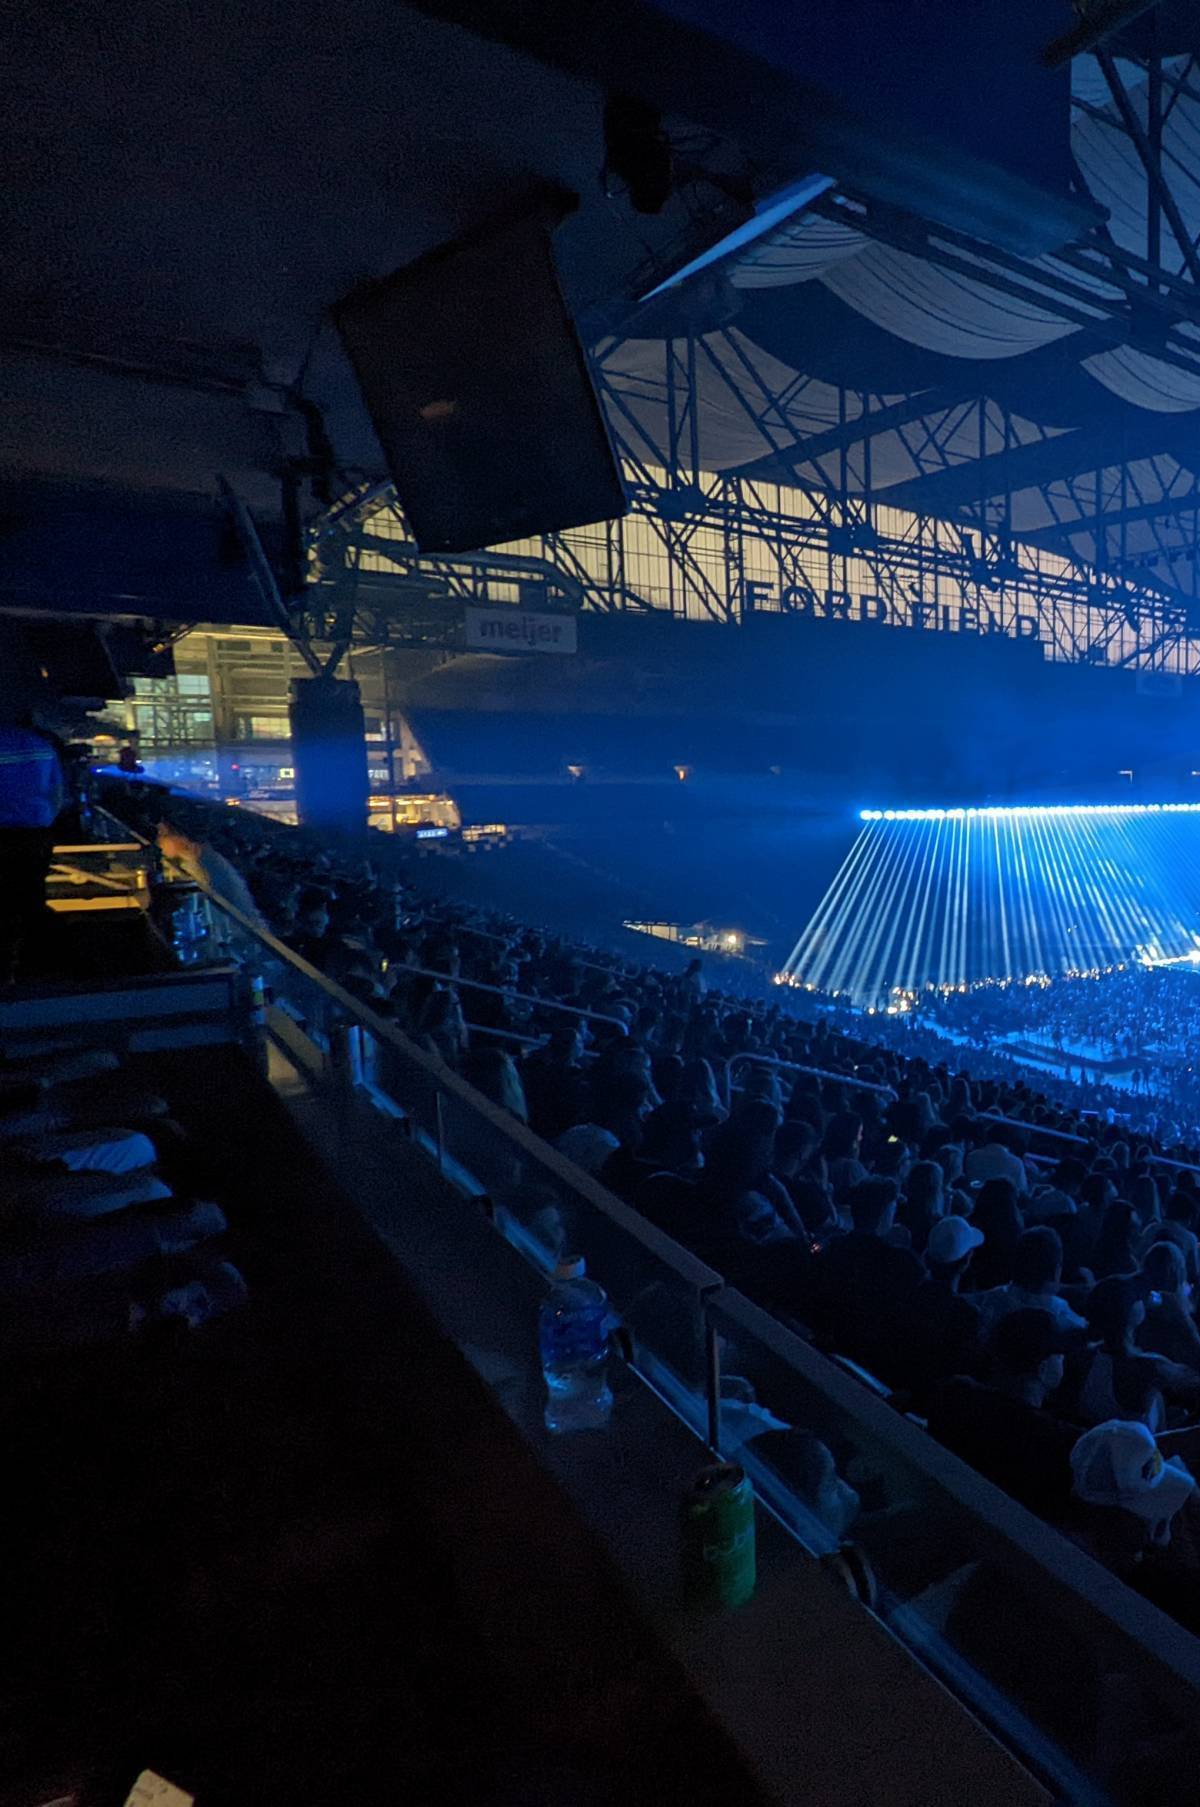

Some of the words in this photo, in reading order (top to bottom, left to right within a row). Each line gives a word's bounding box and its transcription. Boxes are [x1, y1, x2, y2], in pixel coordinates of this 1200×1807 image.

[480, 616, 562, 646] meijer
[746, 580, 888, 625] FORD
[912, 602, 1038, 641] FIELD
